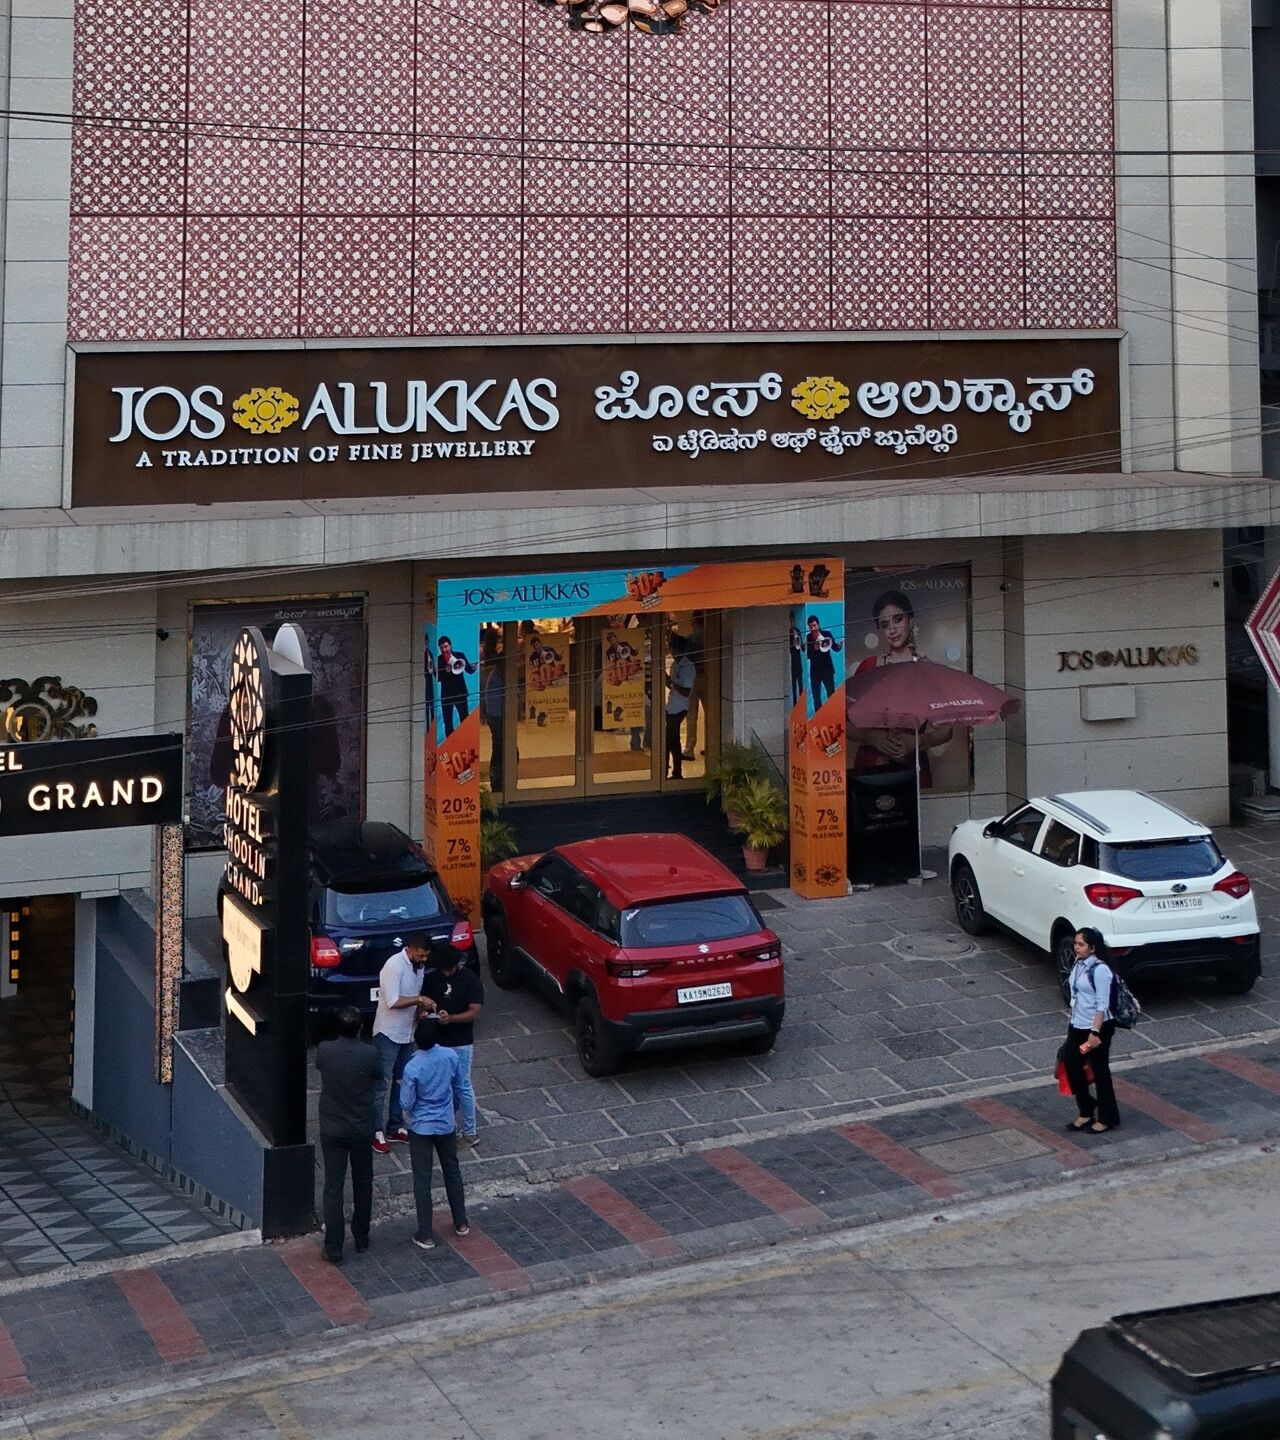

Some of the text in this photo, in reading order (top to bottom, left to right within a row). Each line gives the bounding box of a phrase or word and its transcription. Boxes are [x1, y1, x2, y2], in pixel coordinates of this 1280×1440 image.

[109, 378, 560, 442] JOS ALUKKAS
[135, 439, 536, 468] A TRADITION OF FINE JEWELLERY
[463, 588, 495, 607] JOS
[511, 581, 590, 603] ALUKKAS
[1057, 644, 1200, 672] JOS ALUKKAS
[812, 770, 842, 785] 20%
[28, 777, 164, 811] GRAND
[442, 797, 476, 814] 20%
[226, 785, 263, 844] HOTEL
[817, 809, 838, 825] 7%
[223, 823, 266, 880] SHOOLIN
[447, 839, 471, 855] 7%
[227, 862, 258, 906] GRAND
